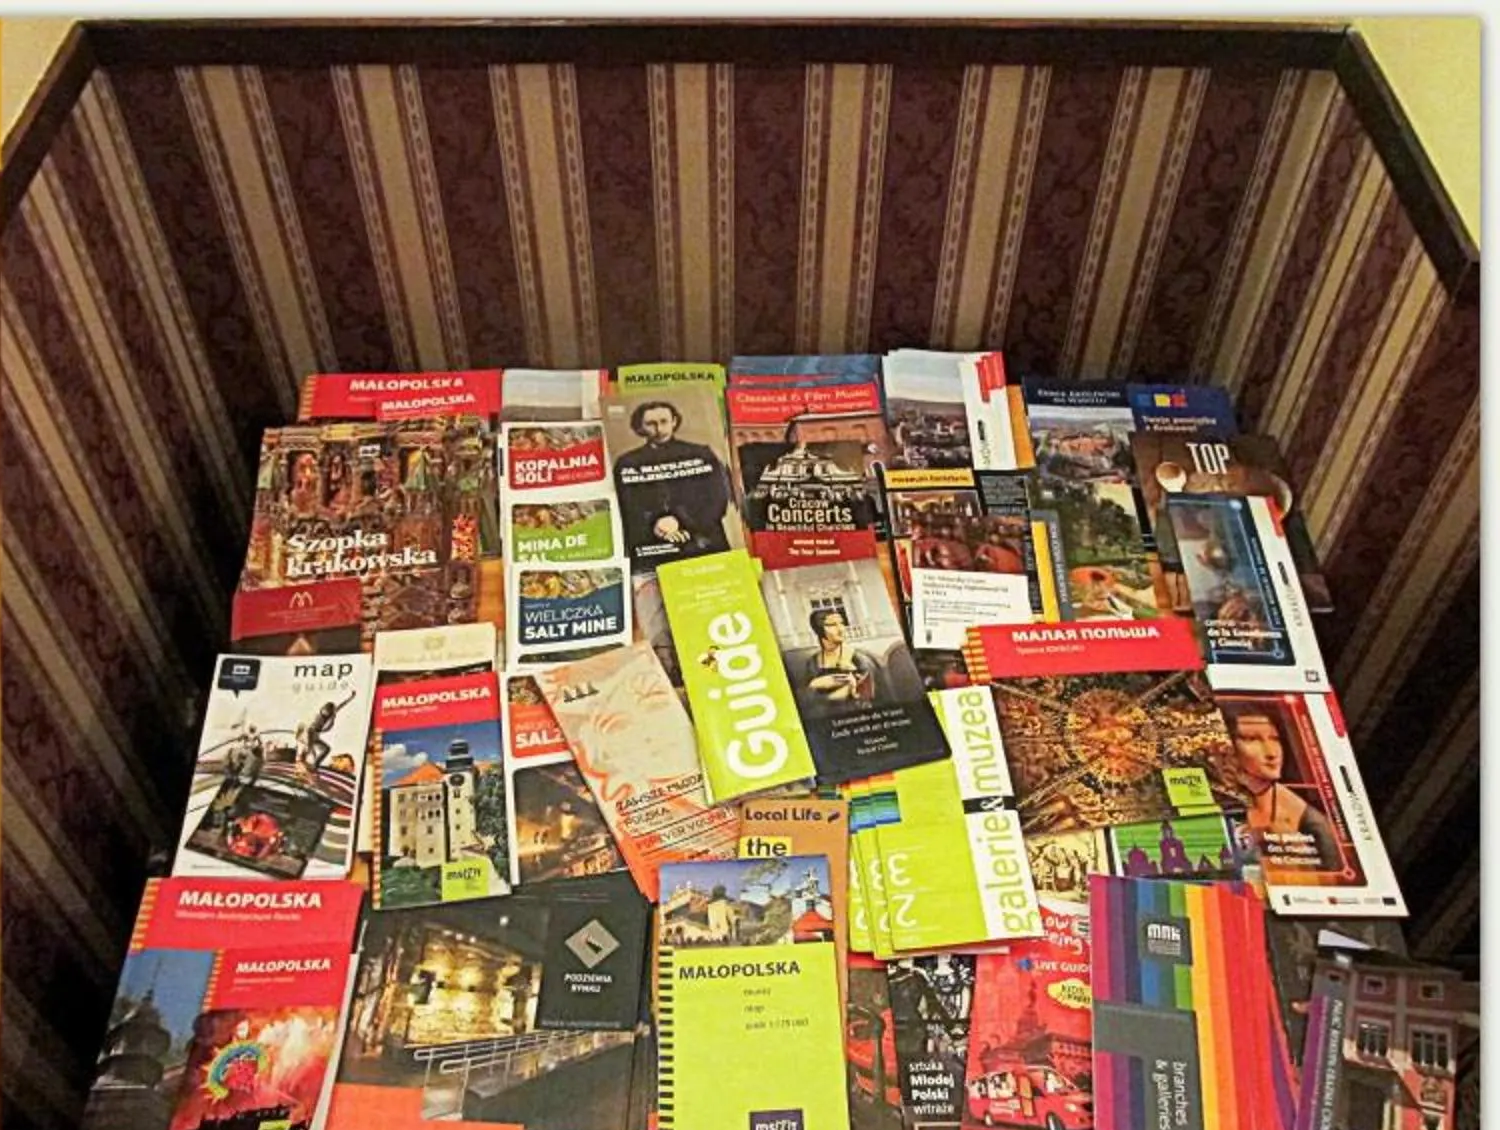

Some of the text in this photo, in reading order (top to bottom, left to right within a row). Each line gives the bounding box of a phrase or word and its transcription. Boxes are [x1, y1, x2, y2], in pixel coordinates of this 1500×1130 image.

[514, 454, 599, 473] KOPALNIA
[1186, 441, 1230, 475] TOP
[515, 471, 553, 484] SOLI
[767, 504, 853, 523] Concerts
[286, 529, 388, 554] Szopka
[517, 534, 588, 553] MINA DE
[525, 604, 604, 623] WIELICZKA
[525, 616, 617, 640] SALT MINE
[1012, 625, 1161, 643] МАЛАЯ ПОЛЬША
[294, 663, 353, 681] map
[381, 686, 492, 709] MAŁOPOLSKA
[708, 611, 789, 779] Guide
[957, 691, 1003, 795] muzea
[745, 807, 822, 821] Local Life
[746, 837, 787, 857] the
[977, 813, 1039, 932] galerie
[178, 889, 323, 909] MAŁOPOLSKA
[235, 958, 332, 974] MAŁOPOLSKA
[679, 960, 801, 981] MAŁOPOLSKA
[1060, 961, 1092, 973] GUID
[911, 1088, 949, 1101] Polski
[1173, 1061, 1189, 1126] branches
